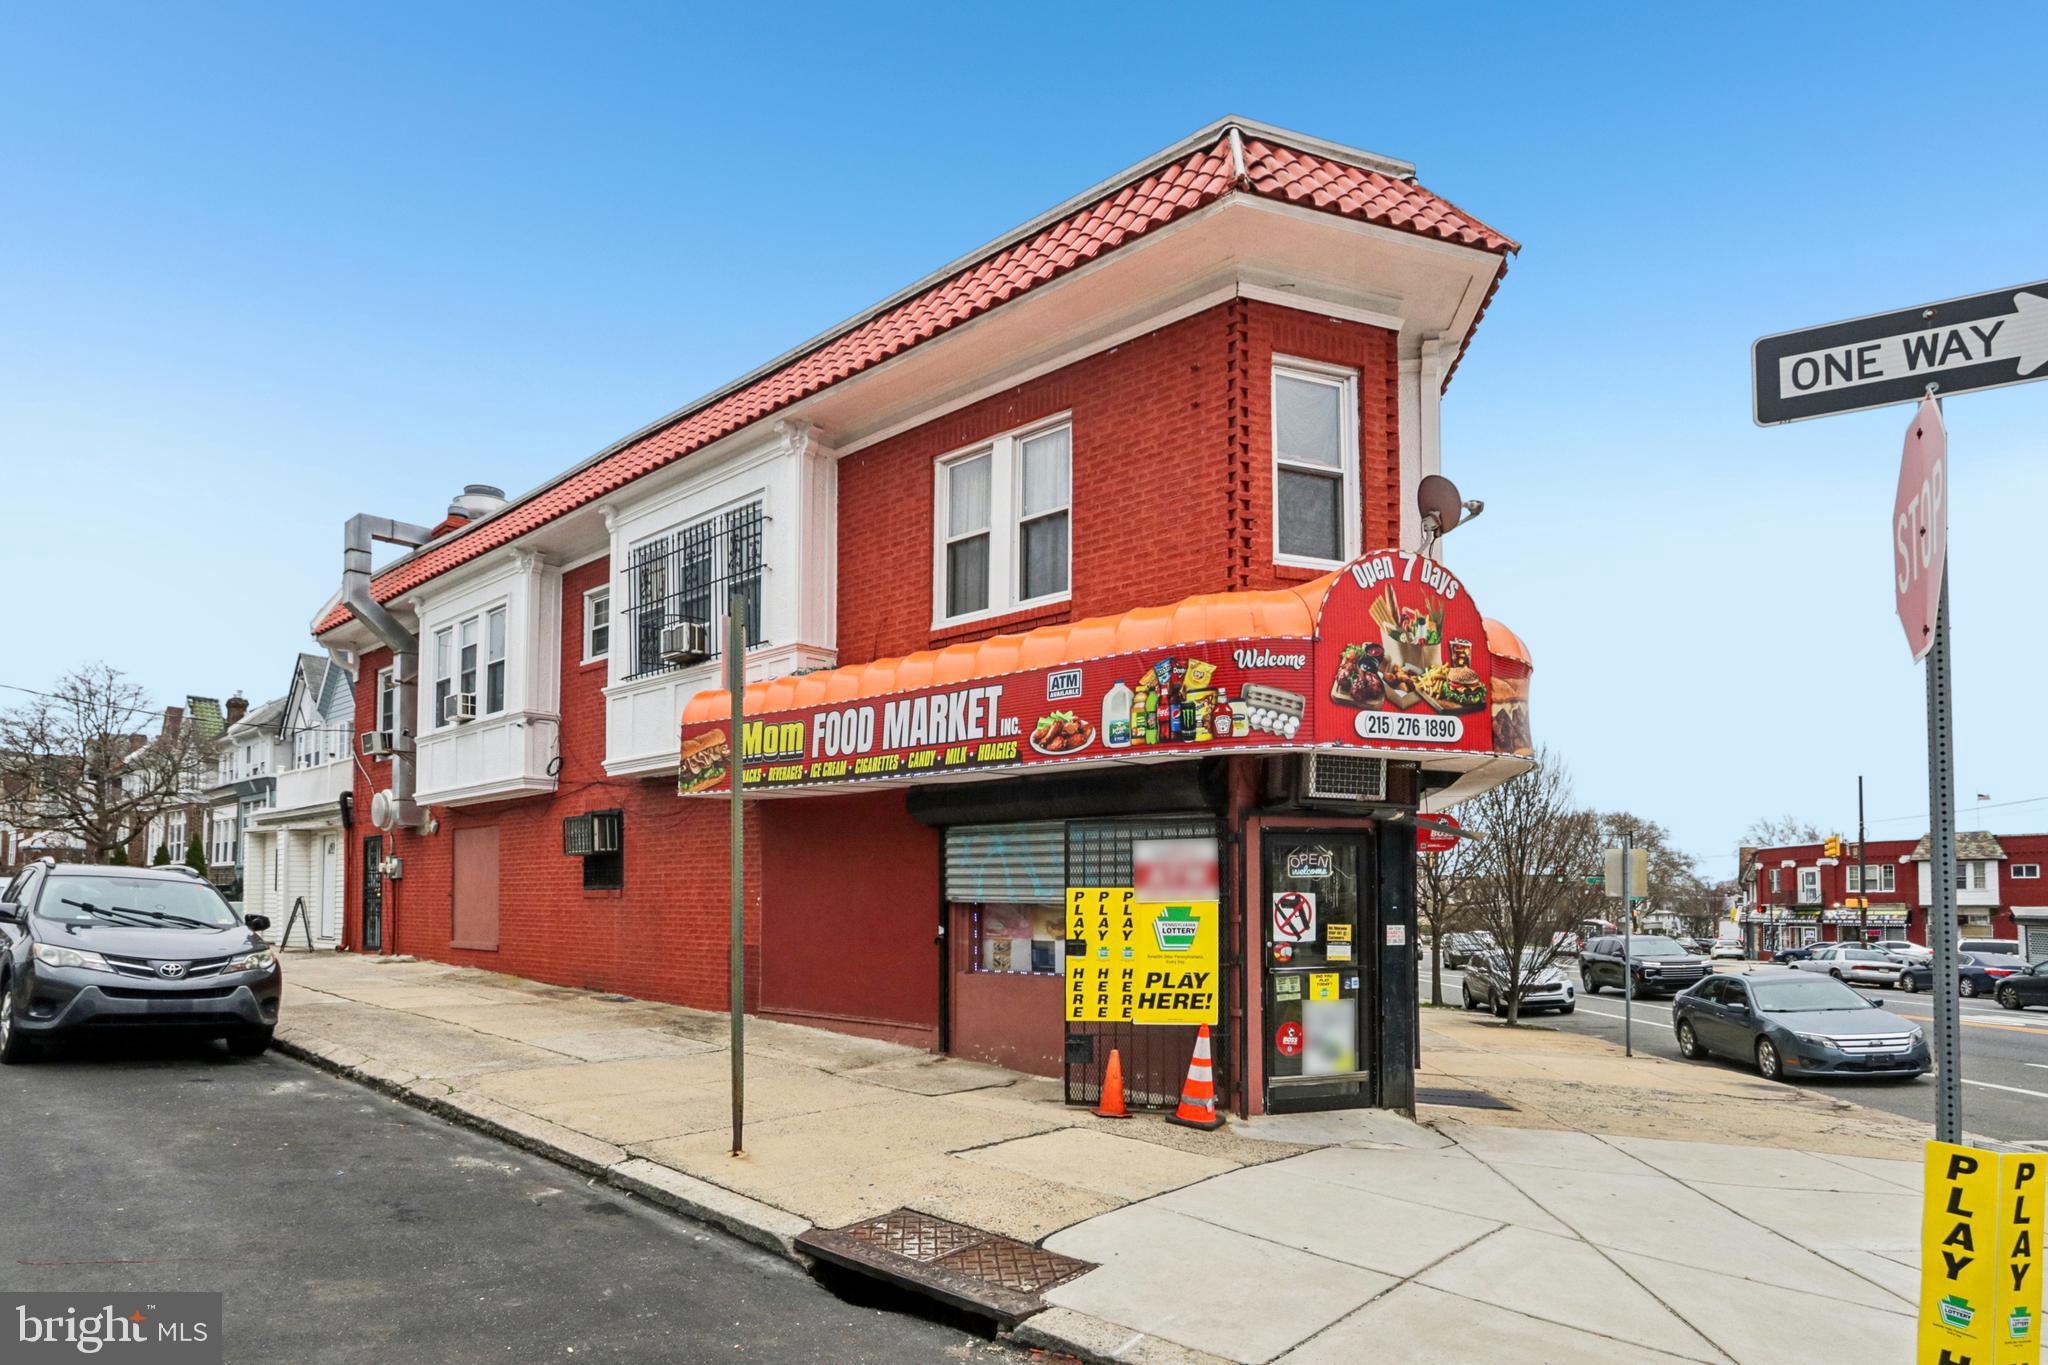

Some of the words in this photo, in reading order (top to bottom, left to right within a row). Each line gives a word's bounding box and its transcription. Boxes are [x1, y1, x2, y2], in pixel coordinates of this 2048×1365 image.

[1791, 343, 1884, 391] ONE
[1902, 319, 2006, 371] WAY
[1897, 457, 1942, 594] STOP
[1352, 555, 1395, 589] Open
[1399, 552, 1417, 582] 7
[1420, 558, 1459, 600] Days
[1051, 672, 1078, 691] ATM
[1233, 648, 1306, 670] Welcome
[1050, 687, 1080, 698] AVAILABLE
[743, 720, 805, 761] Mom
[811, 705, 875, 759] FOOD
[882, 684, 1004, 751] MARKET
[1000, 717, 1022, 737] INC.
[1365, 714, 1394, 737] (215)
[1397, 717, 1456, 738] 276-1890
[768, 764, 804, 781] BEVERAGES
[810, 762, 823, 778] ICE
[823, 760, 847, 777] CREAM
[855, 754, 899, 774] CIGARETTES
[908, 750, 937, 769] CANDY
[945, 746, 968, 765] MILK
[977, 741, 1018, 762] HOAGIES
[1290, 853, 1329, 868] OPEN
[1098, 891, 1109, 941] PLAY
[1122, 891, 1134, 941] PLAY
[1073, 968, 1085, 1018] HERE
[1097, 968, 1109, 1018] HERE
[1122, 968, 1134, 1018] HERE
[1138, 992, 1213, 1010] HERE!
[1145, 972, 1210, 989] PLAY
[1941, 1153, 1979, 1281] PLAY
[2010, 1162, 2036, 1292] PLAY
[1944, 1308, 1971, 1320] LOTTERY
